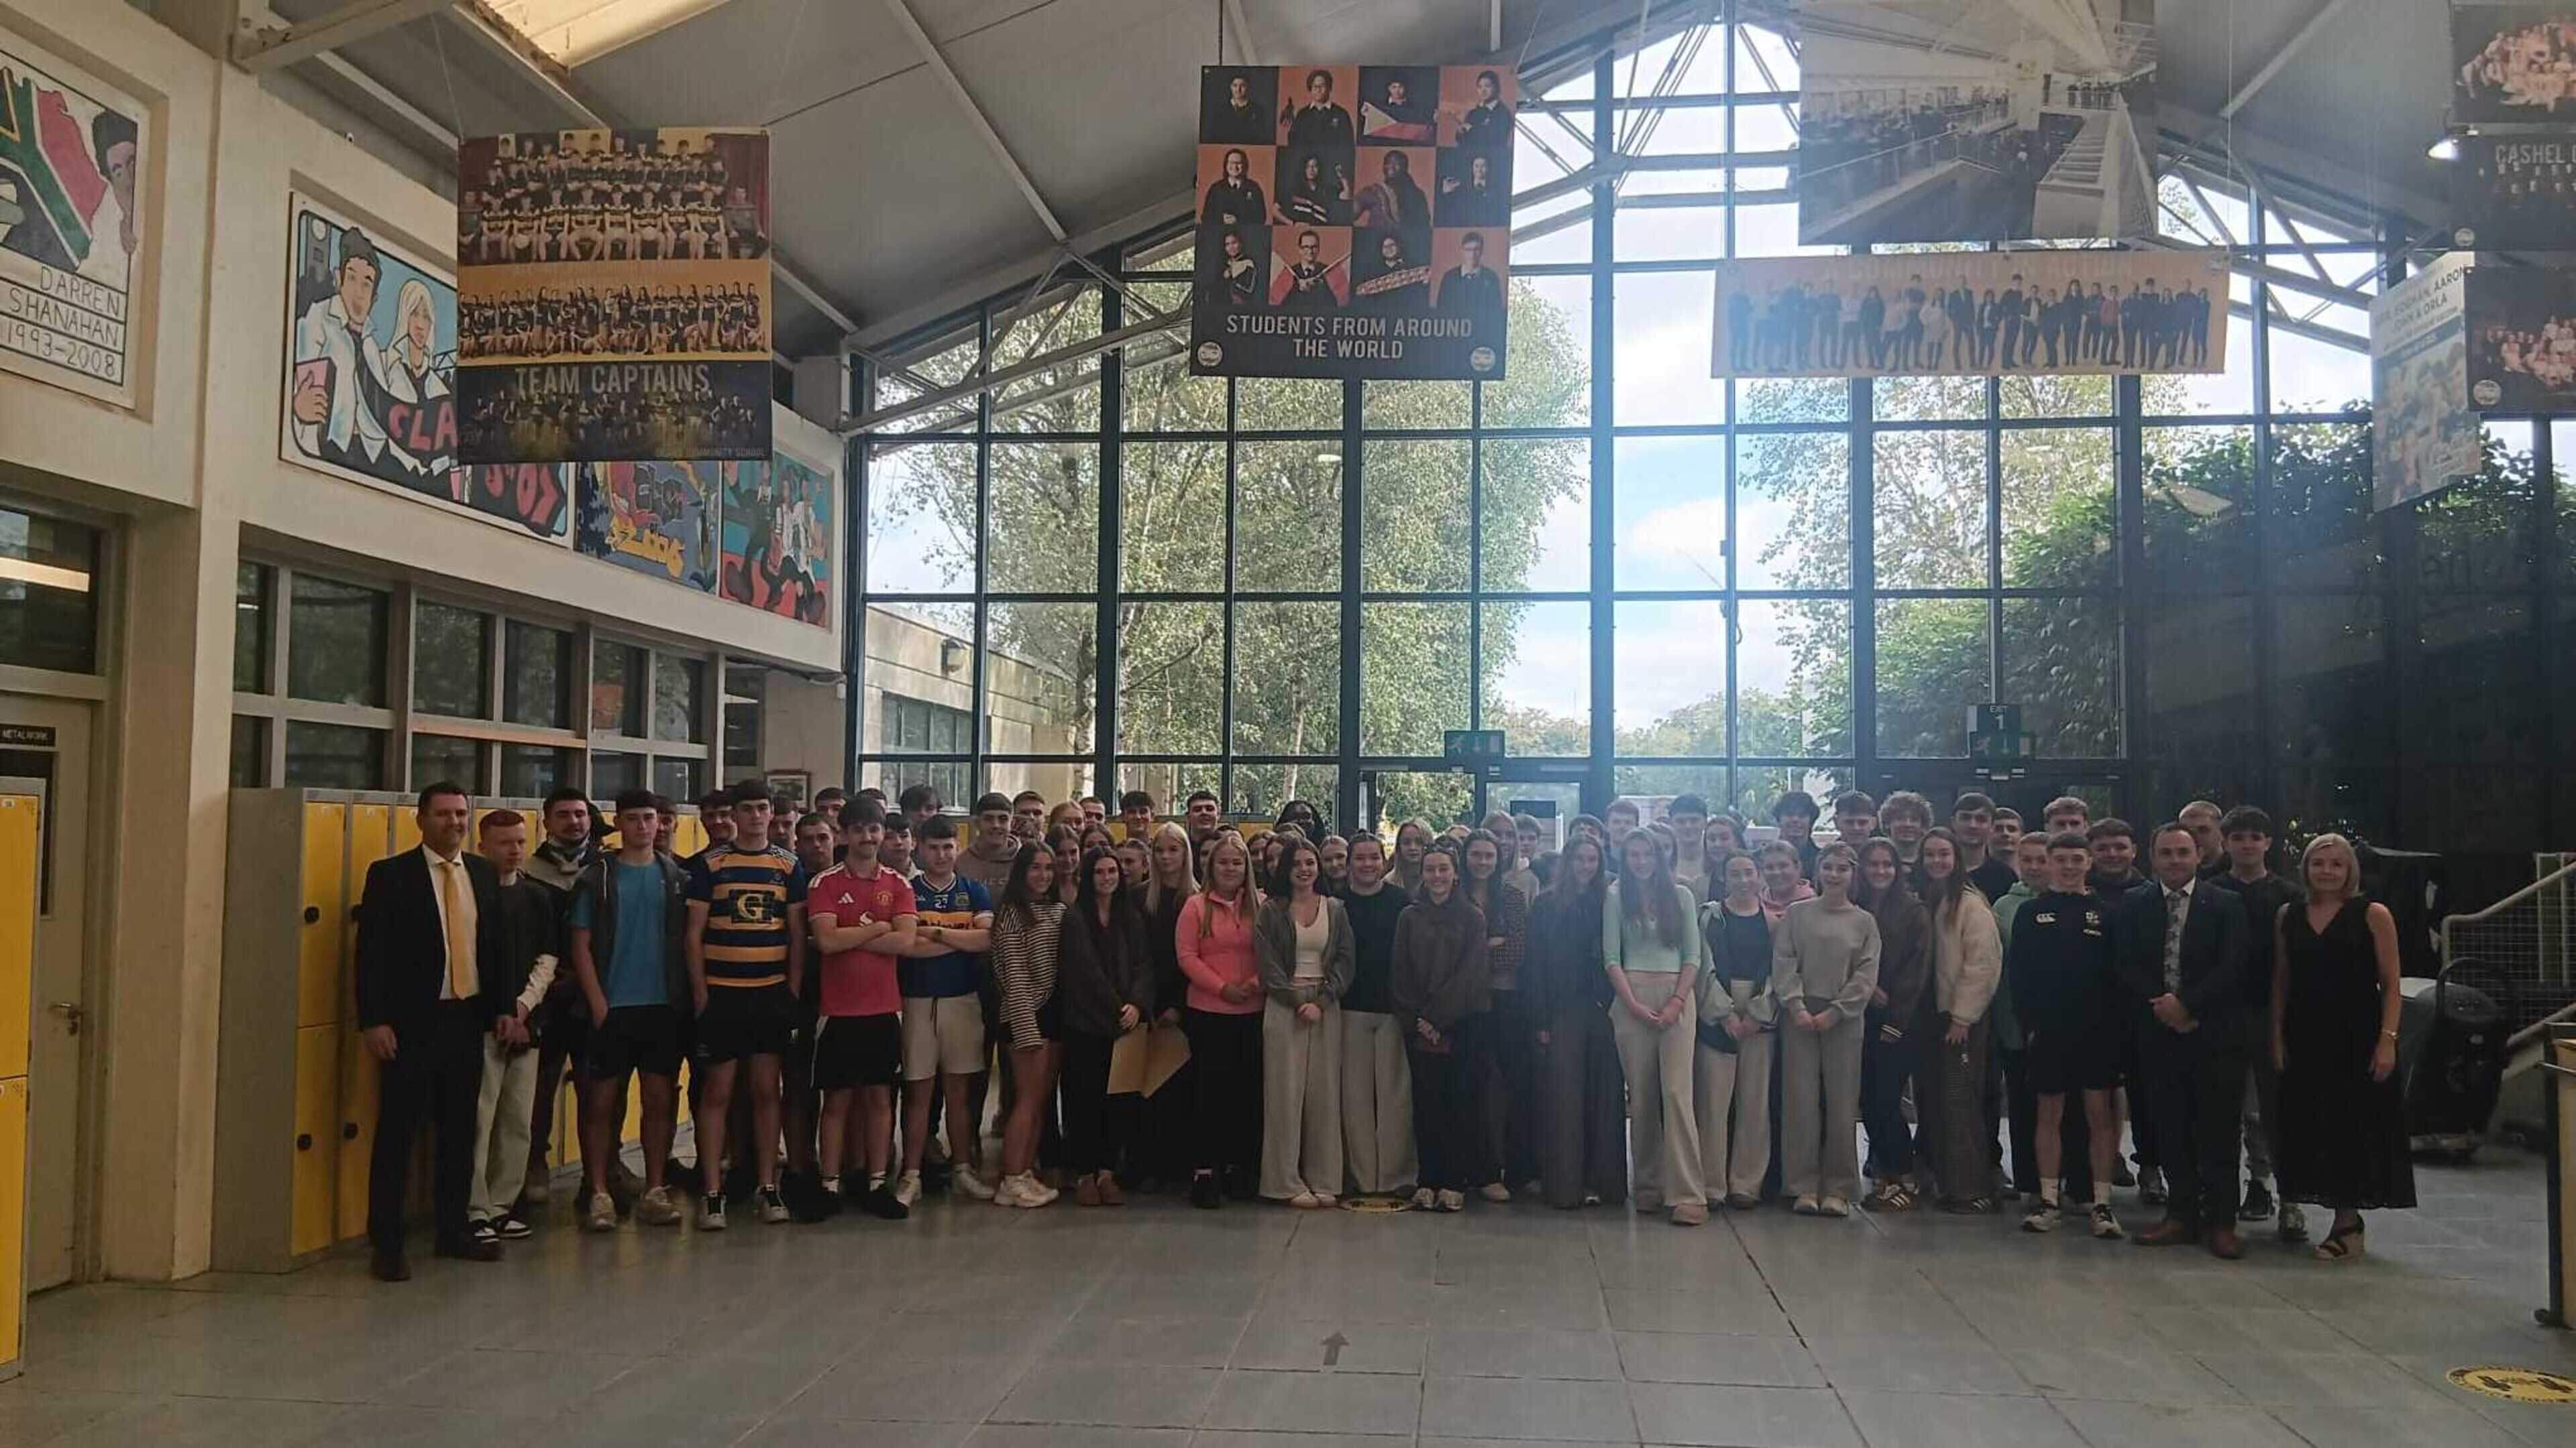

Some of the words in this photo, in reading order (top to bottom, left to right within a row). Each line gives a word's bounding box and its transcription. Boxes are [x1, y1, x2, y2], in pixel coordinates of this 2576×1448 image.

[2496, 144, 2566, 164] CASHEL
[40, 266, 119, 317] DARREN
[9, 287, 119, 347] SHANAHAN
[1226, 315, 1325, 335] STUDENTS
[1332, 317, 1386, 337] FROM
[1393, 318, 1472, 337] AROUND
[8, 321, 115, 377] 1993-2008
[1293, 338, 1328, 357] THE
[1337, 339, 1403, 359] WORLD
[515, 366, 580, 396] TEAM
[590, 364, 710, 394] CAPTAINS
